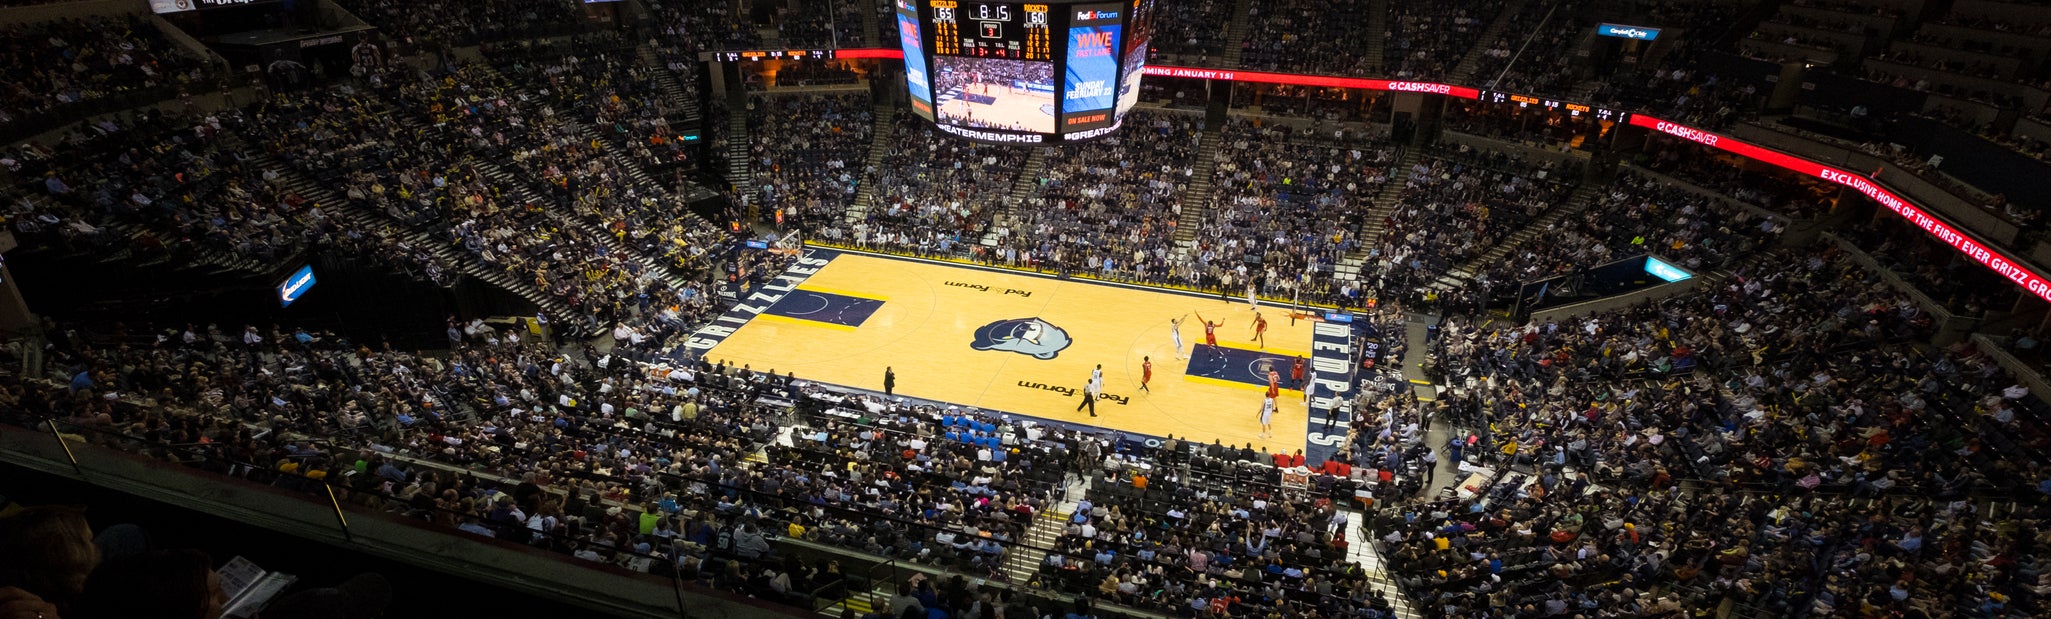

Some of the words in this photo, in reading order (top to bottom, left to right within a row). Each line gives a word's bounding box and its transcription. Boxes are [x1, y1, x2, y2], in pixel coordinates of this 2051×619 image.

[930, 0, 957, 8] GRIZZLIES
[1024, 4, 1048, 12] ROCKETS
[939, 8, 952, 19] 65
[980, 5, 1008, 20] 8:15
[1031, 12, 1044, 23] 60
[1077, 10, 1117, 20] FedExForum
[988, 28, 993, 37] 3
[1076, 32, 1112, 48] WWE
[1093, 48, 1111, 56] LANE
[1141, 67, 1171, 76] OMING
[1172, 69, 1216, 79] JANUARY
[1075, 80, 1105, 91] SUNDAY
[1397, 81, 1451, 95] CASHSAVER
[1066, 87, 1102, 99] FEBRUARY
[1103, 87, 1112, 95] 22
[1511, 95, 1539, 105] GRIZZLIES
[1545, 100, 1559, 108] 8:15
[1565, 103, 1590, 113] ROCKETS
[1078, 115, 1091, 124] SALE
[1092, 114, 1106, 122] NOW
[935, 123, 1043, 143] REATERMEMPHIS
[1665, 123, 1718, 146] CASHSAVER
[1820, 169, 1878, 198] EXCLUSIVE
[1876, 191, 1904, 212] HOME
[1902, 206, 1916, 219] OF
[1915, 213, 1934, 231] THE
[1933, 224, 1963, 247] FIRST
[1961, 240, 1991, 263] EVER
[1991, 258, 2028, 285] GRIZZ
[944, 281, 1032, 297] FedForum
[683, 255, 829, 349] GRIZZLIES
[1308, 322, 1350, 449] MEMPHIS
[1017, 380, 1129, 405] FedForum
[717, 537, 729, 550] 50
